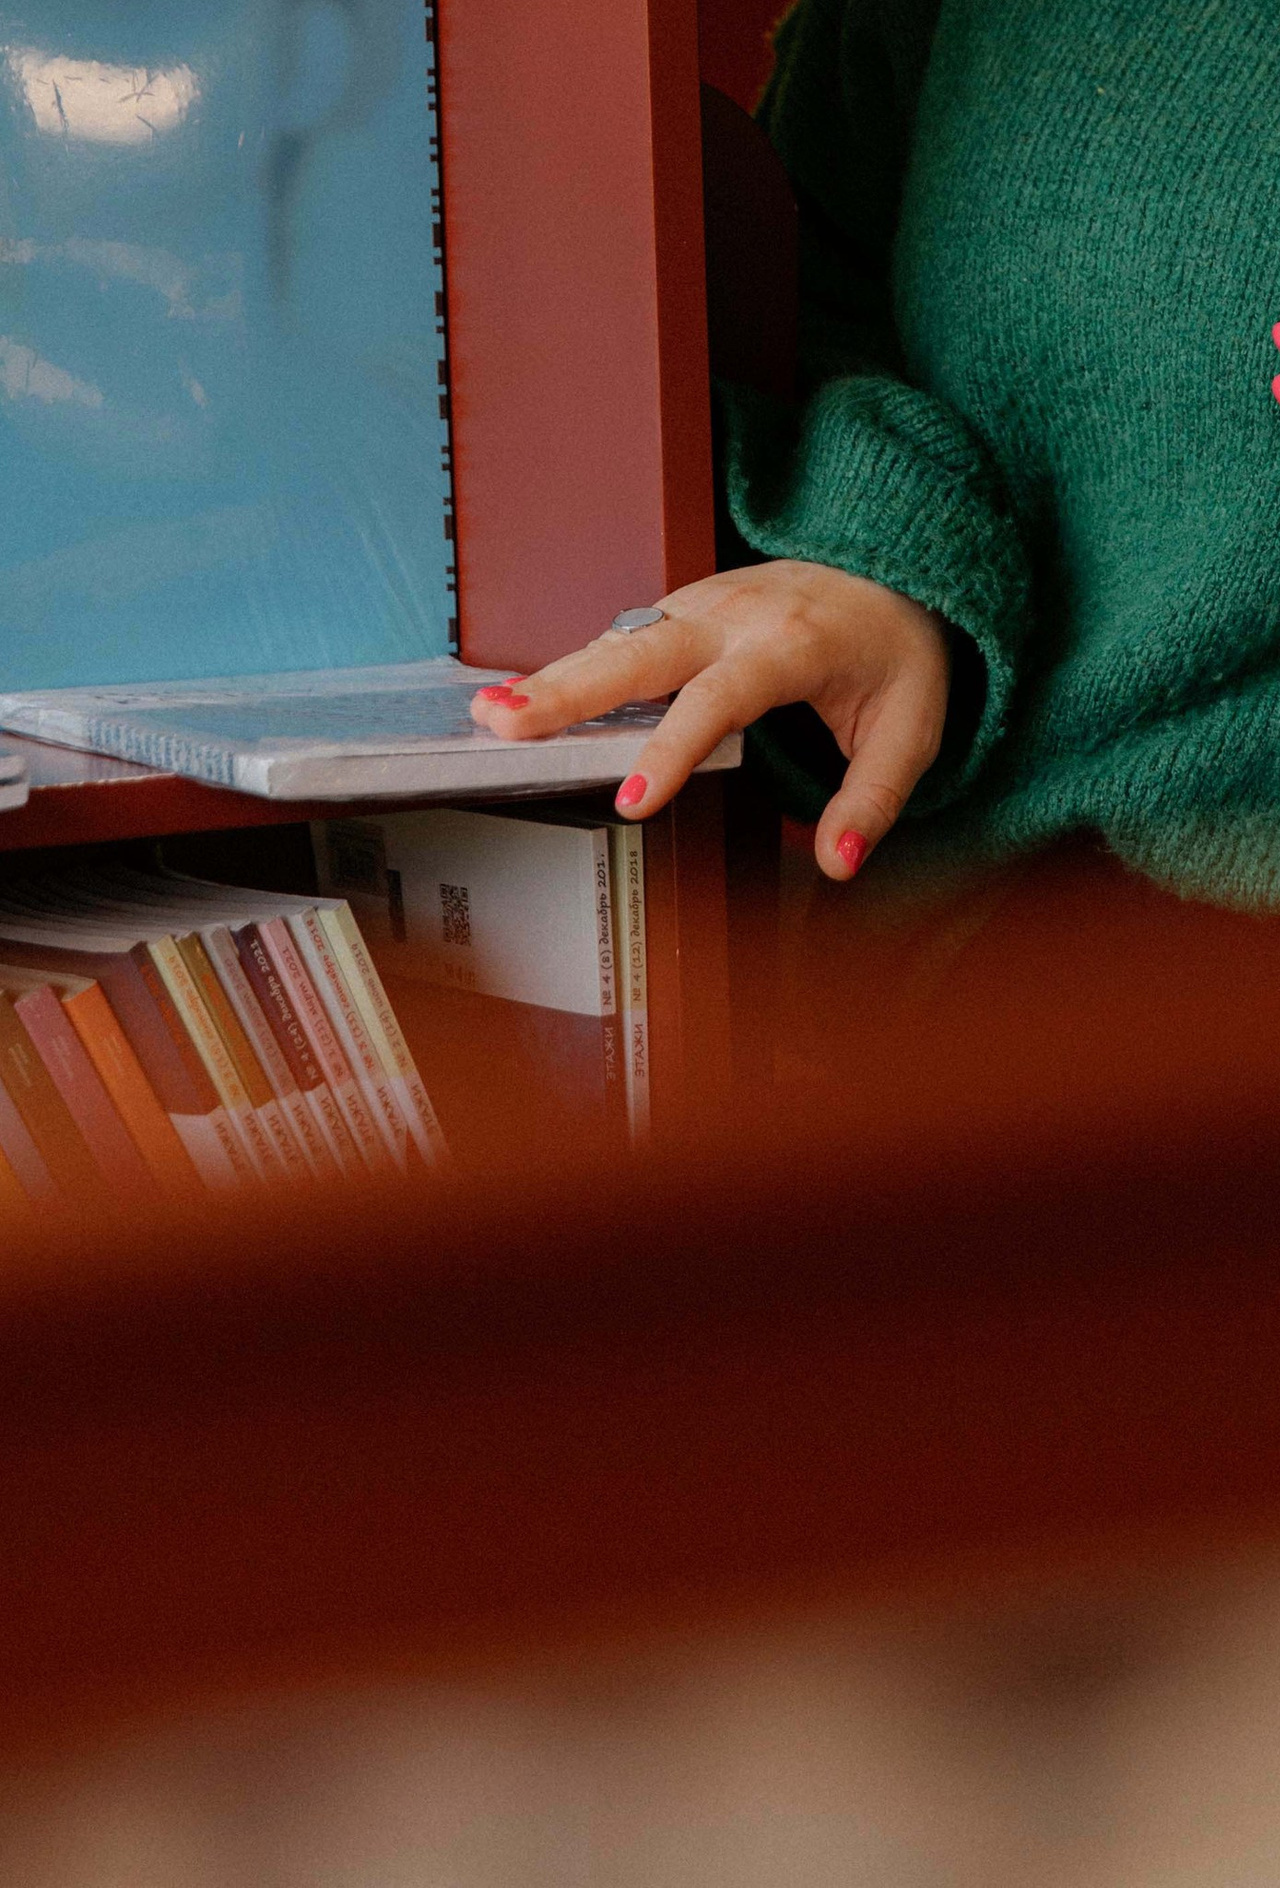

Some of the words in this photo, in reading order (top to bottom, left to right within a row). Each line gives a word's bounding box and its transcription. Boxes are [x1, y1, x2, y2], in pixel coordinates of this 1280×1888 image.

[629, 850, 640, 885] 2018
[599, 892, 611, 944] декабрь
[630, 892, 643, 938] декабрь
[248, 938, 270, 974] 2021
[631, 941, 643, 968] (12)
[604, 975, 611, 986] 4
[633, 971, 641, 982] 4
[603, 990, 612, 1006] №
[632, 987, 641, 1002] №
[605, 1026, 617, 1081] ЭТАЖИ
[634, 1023, 645, 1078] ЭТАЖИ
